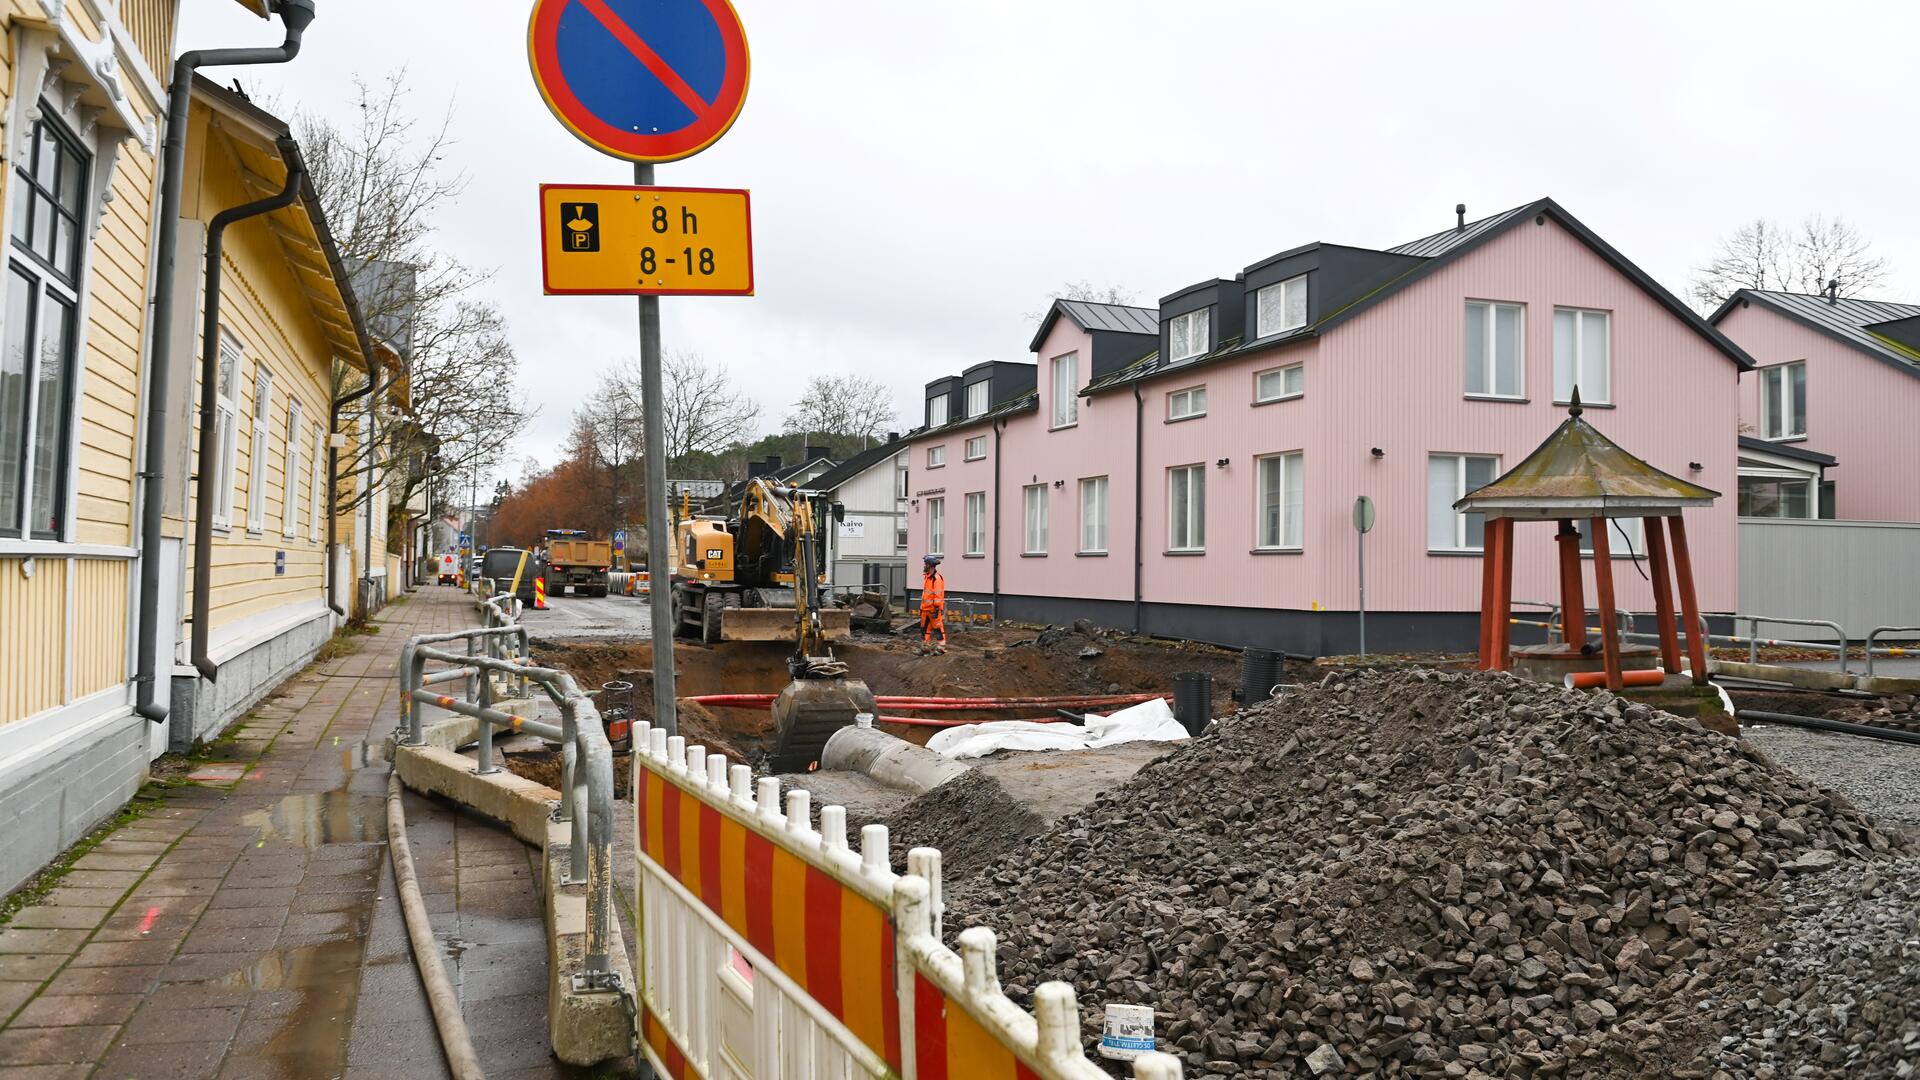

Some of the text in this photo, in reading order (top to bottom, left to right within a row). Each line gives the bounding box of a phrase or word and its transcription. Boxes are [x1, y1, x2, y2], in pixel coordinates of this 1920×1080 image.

[651, 205, 698, 235] 8 h
[575, 234, 587, 247] P
[707, 550, 722, 559] CAT
